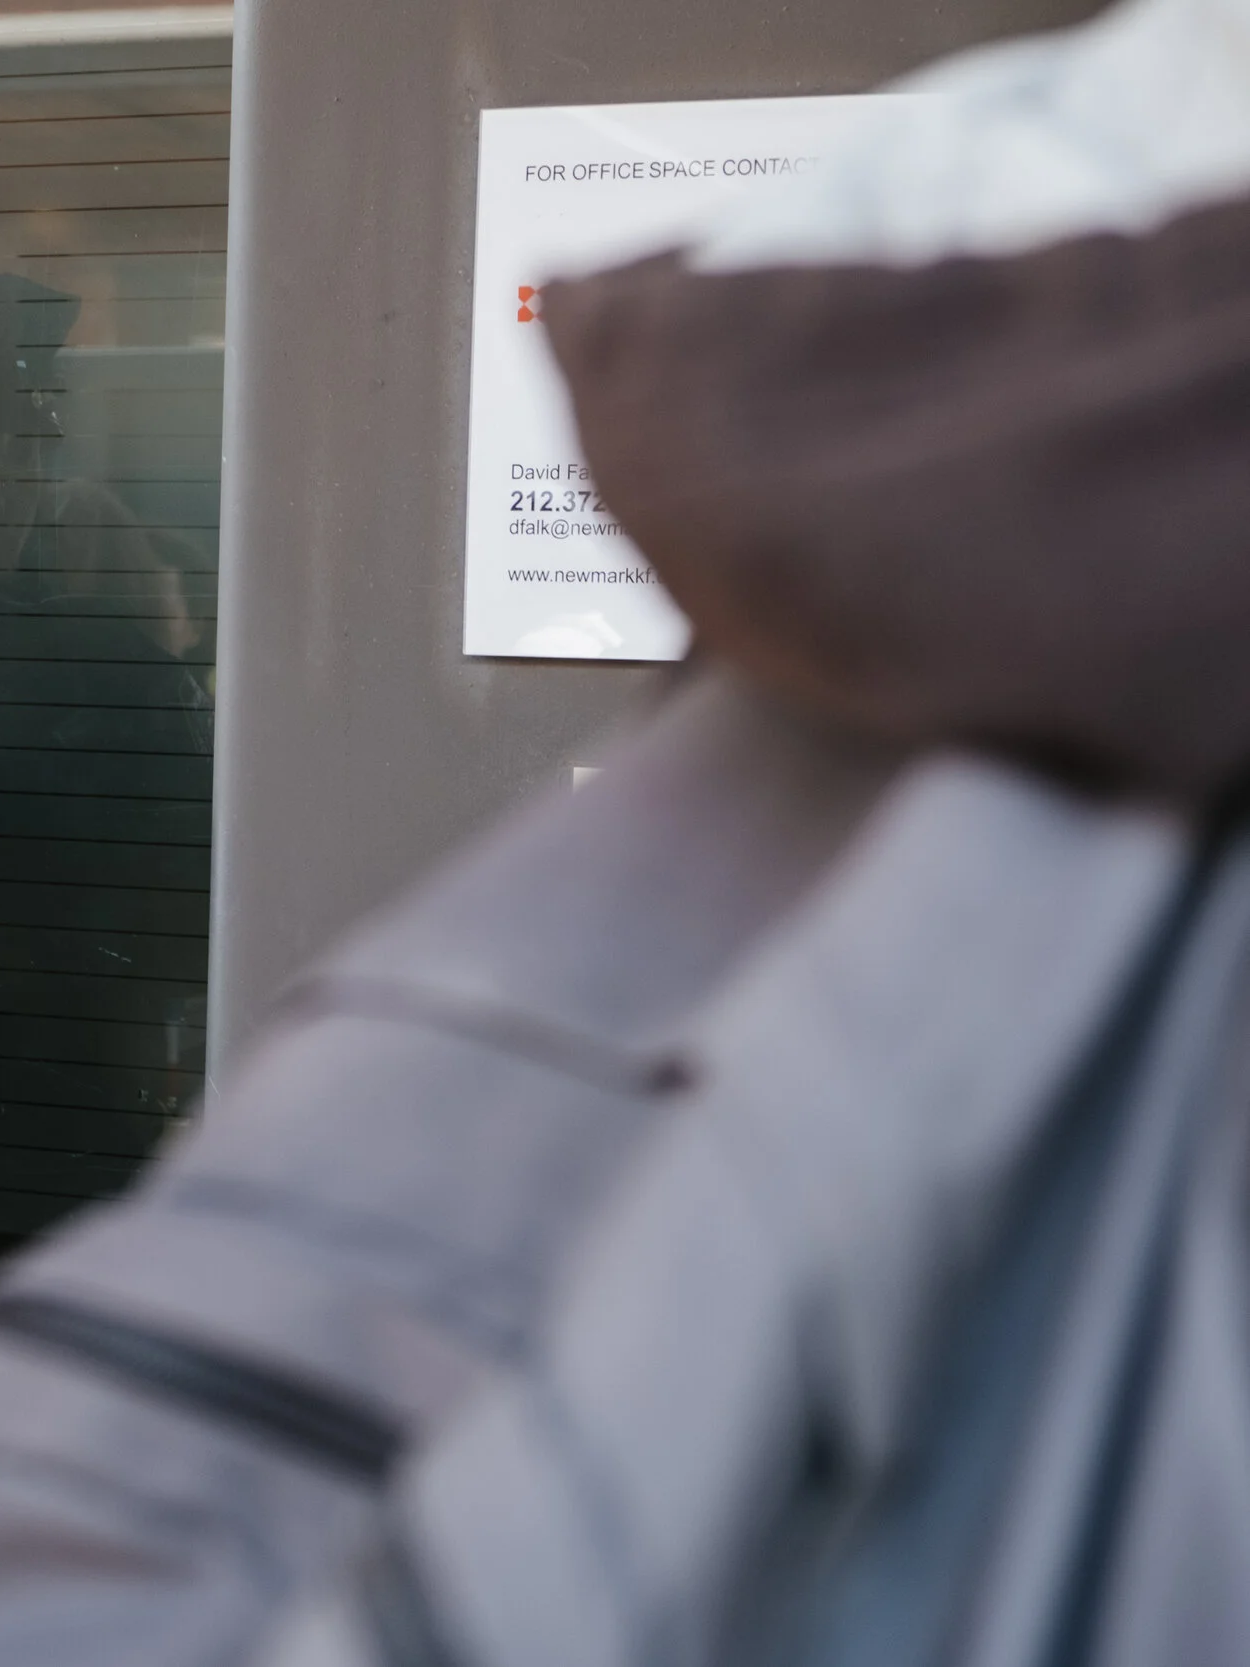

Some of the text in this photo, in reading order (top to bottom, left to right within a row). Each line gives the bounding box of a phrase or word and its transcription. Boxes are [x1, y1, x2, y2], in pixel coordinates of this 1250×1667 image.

[524, 164, 566, 182] FOR
[572, 162, 644, 181] OFFICE
[649, 159, 716, 179] SPACE
[510, 463, 591, 481] David Fa
[509, 490, 608, 513] 212.372
[508, 518, 625, 540] dfalk@newm
